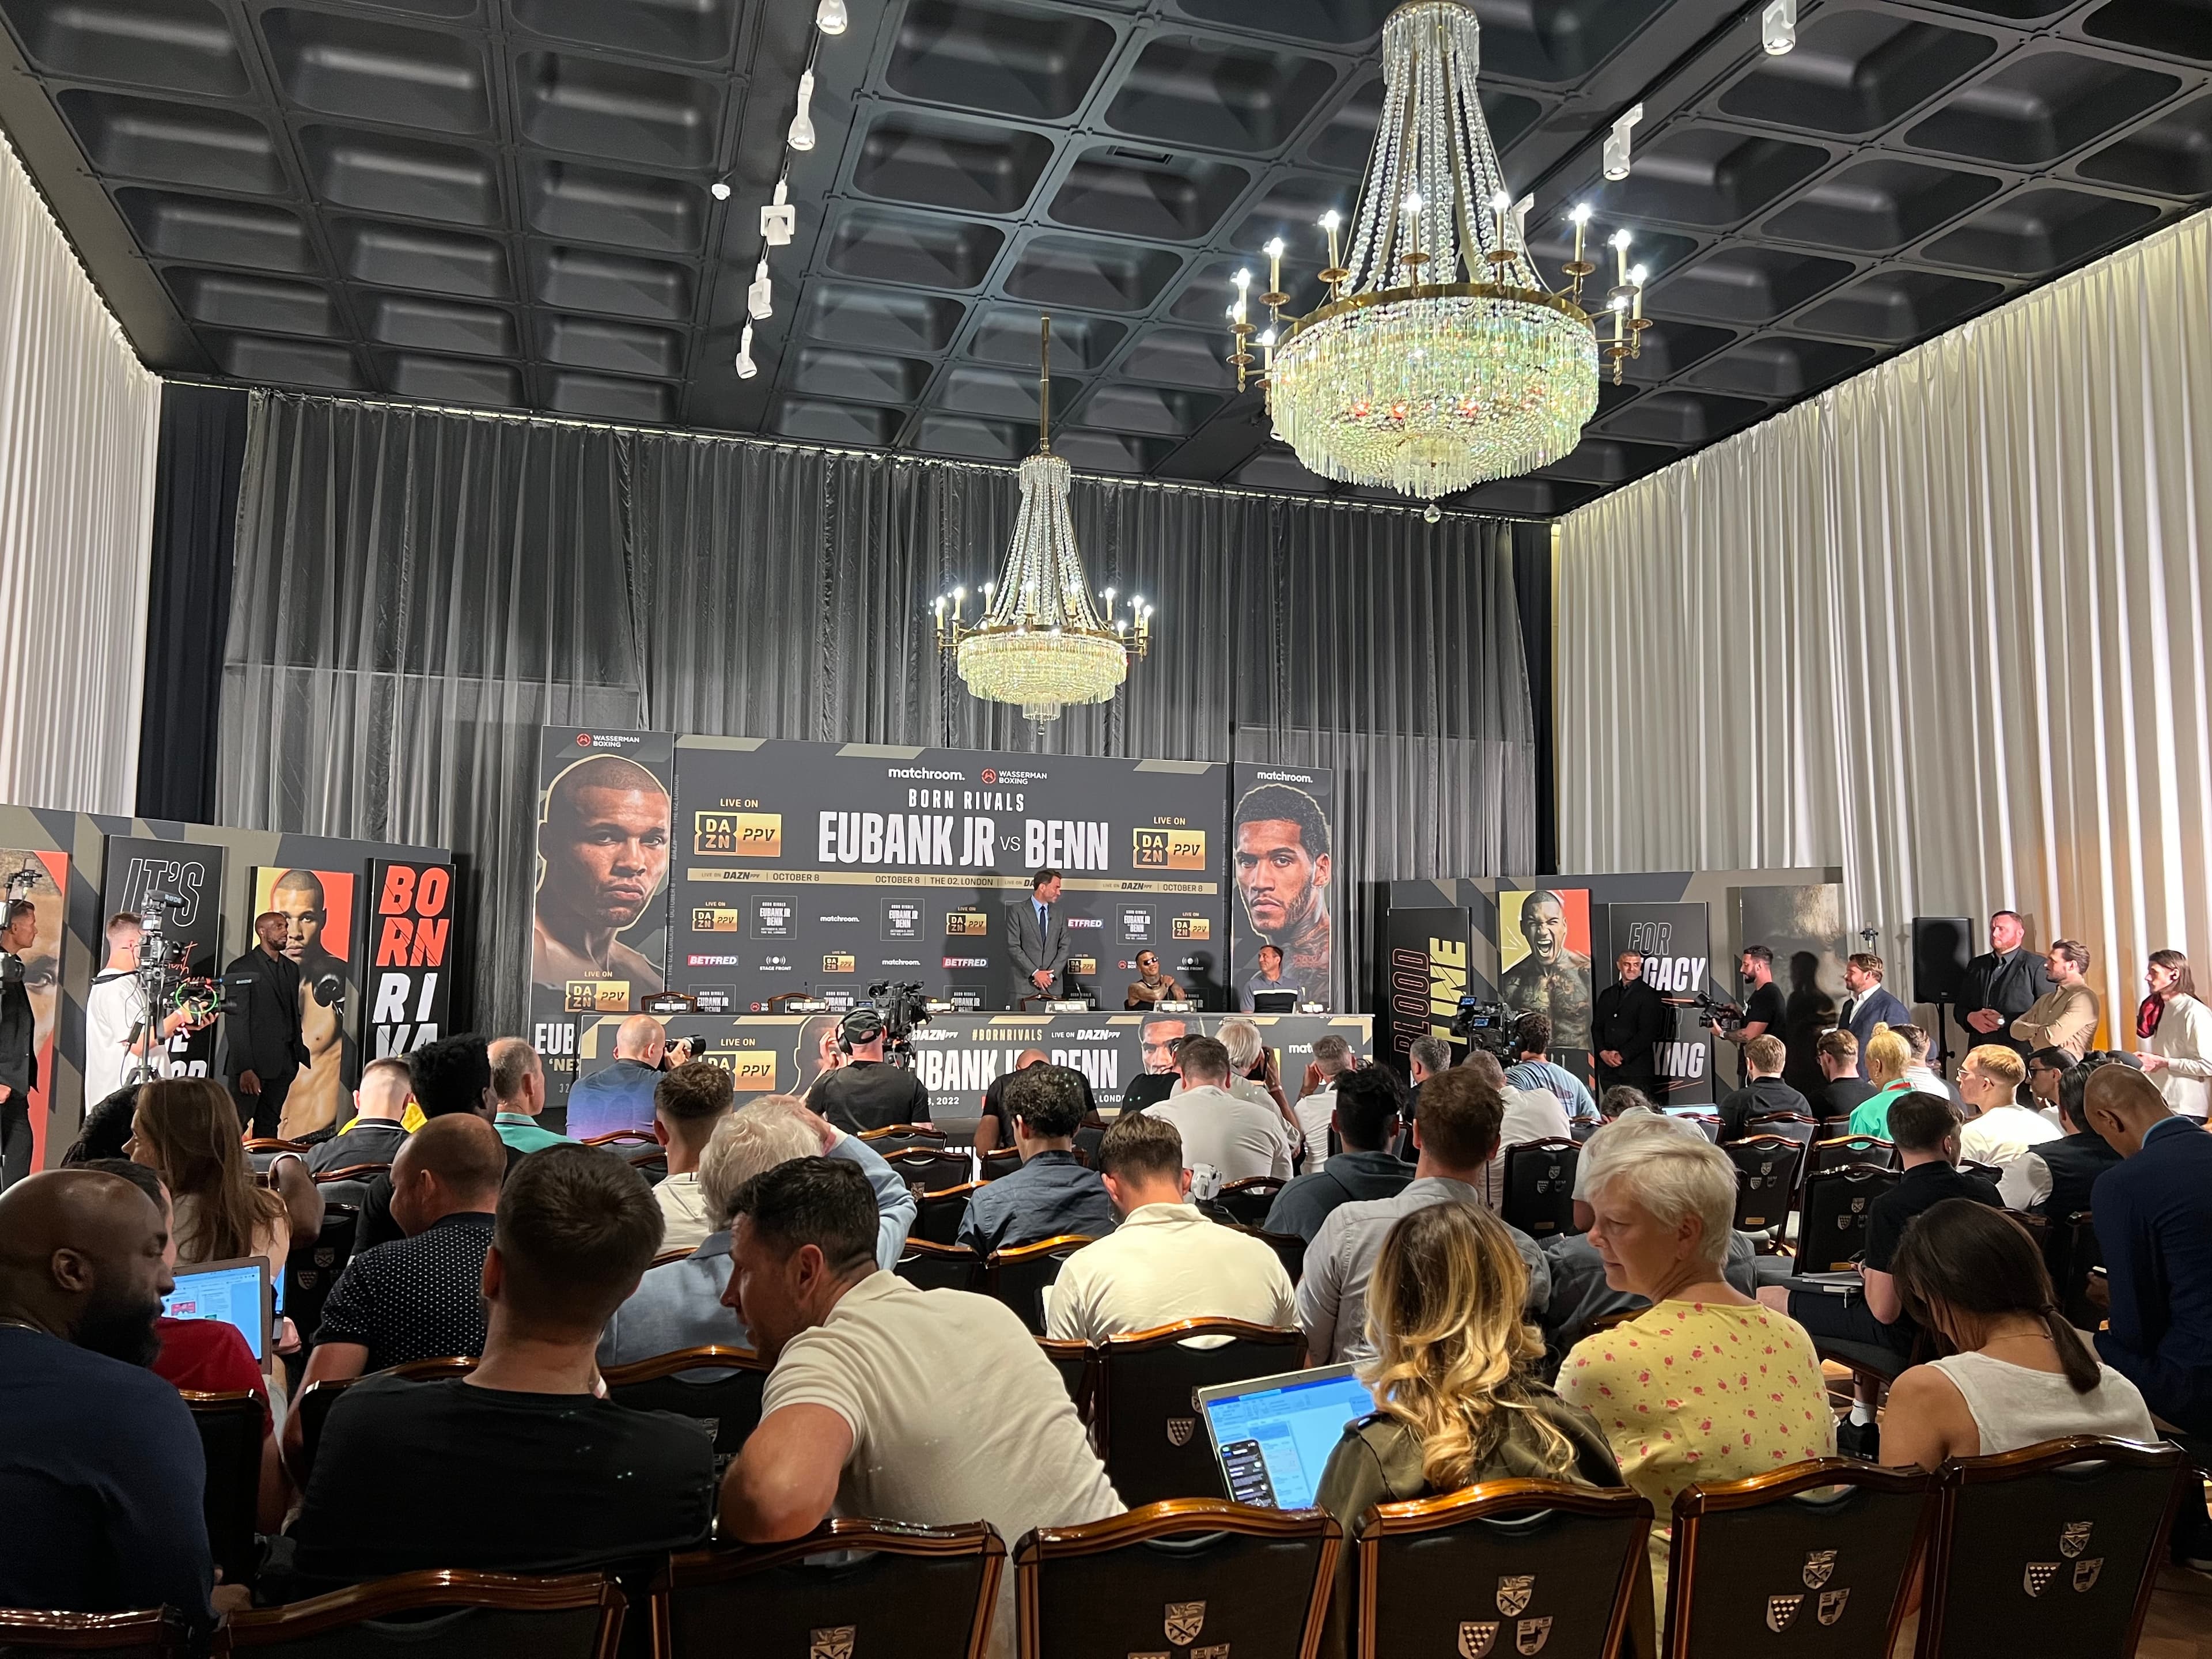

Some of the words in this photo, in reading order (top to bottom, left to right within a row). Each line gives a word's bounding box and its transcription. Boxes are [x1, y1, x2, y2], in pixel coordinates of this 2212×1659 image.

[593, 734, 640, 743] WASSERMAN
[888, 767, 965, 781] matchroom.
[999, 770, 1047, 779] WASSERMAN
[1257, 771, 1313, 783] matchroom.
[720, 798, 741, 808] LIVE
[744, 799, 759, 808] ON
[908, 788, 954, 809] BORN
[964, 791, 1024, 812] RIVALS
[1153, 816, 1171, 825] LIVE
[1173, 817, 1185, 825] ON
[743, 828, 775, 842] PPV
[819, 811, 954, 865] EUBANK
[960, 816, 995, 867] JR
[1025, 819, 1109, 870] BENN
[1173, 844, 1200, 856] PPV
[723, 871, 750, 880] DAZN
[773, 873, 812, 881] OCTOBER
[875, 876, 912, 884] OCTOBER
[930, 877, 945, 885] THE
[961, 878, 993, 886] LONDON
[1163, 884, 1196, 892] OCTOBER
[1067, 919, 1102, 927] ETFRED
[1628, 922, 1672, 956] FOR
[690, 956, 737, 965] BETFRED
[944, 959, 987, 967] BETFRED
[1641, 956, 1706, 992] GACY
[600, 991, 625, 1001] PPV
[697, 997, 721, 1007] EUBANK
[535, 1024, 575, 1055] EUB
[972, 1029, 1042, 1041] #BORNRIVALS
[1077, 1029, 1109, 1040] DAZN
[741, 1065, 771, 1077] PPV
[916, 1049, 998, 1091] BANK
[936, 1096, 960, 1105] 2022
[1099, 1094, 1124, 1103] LOND
